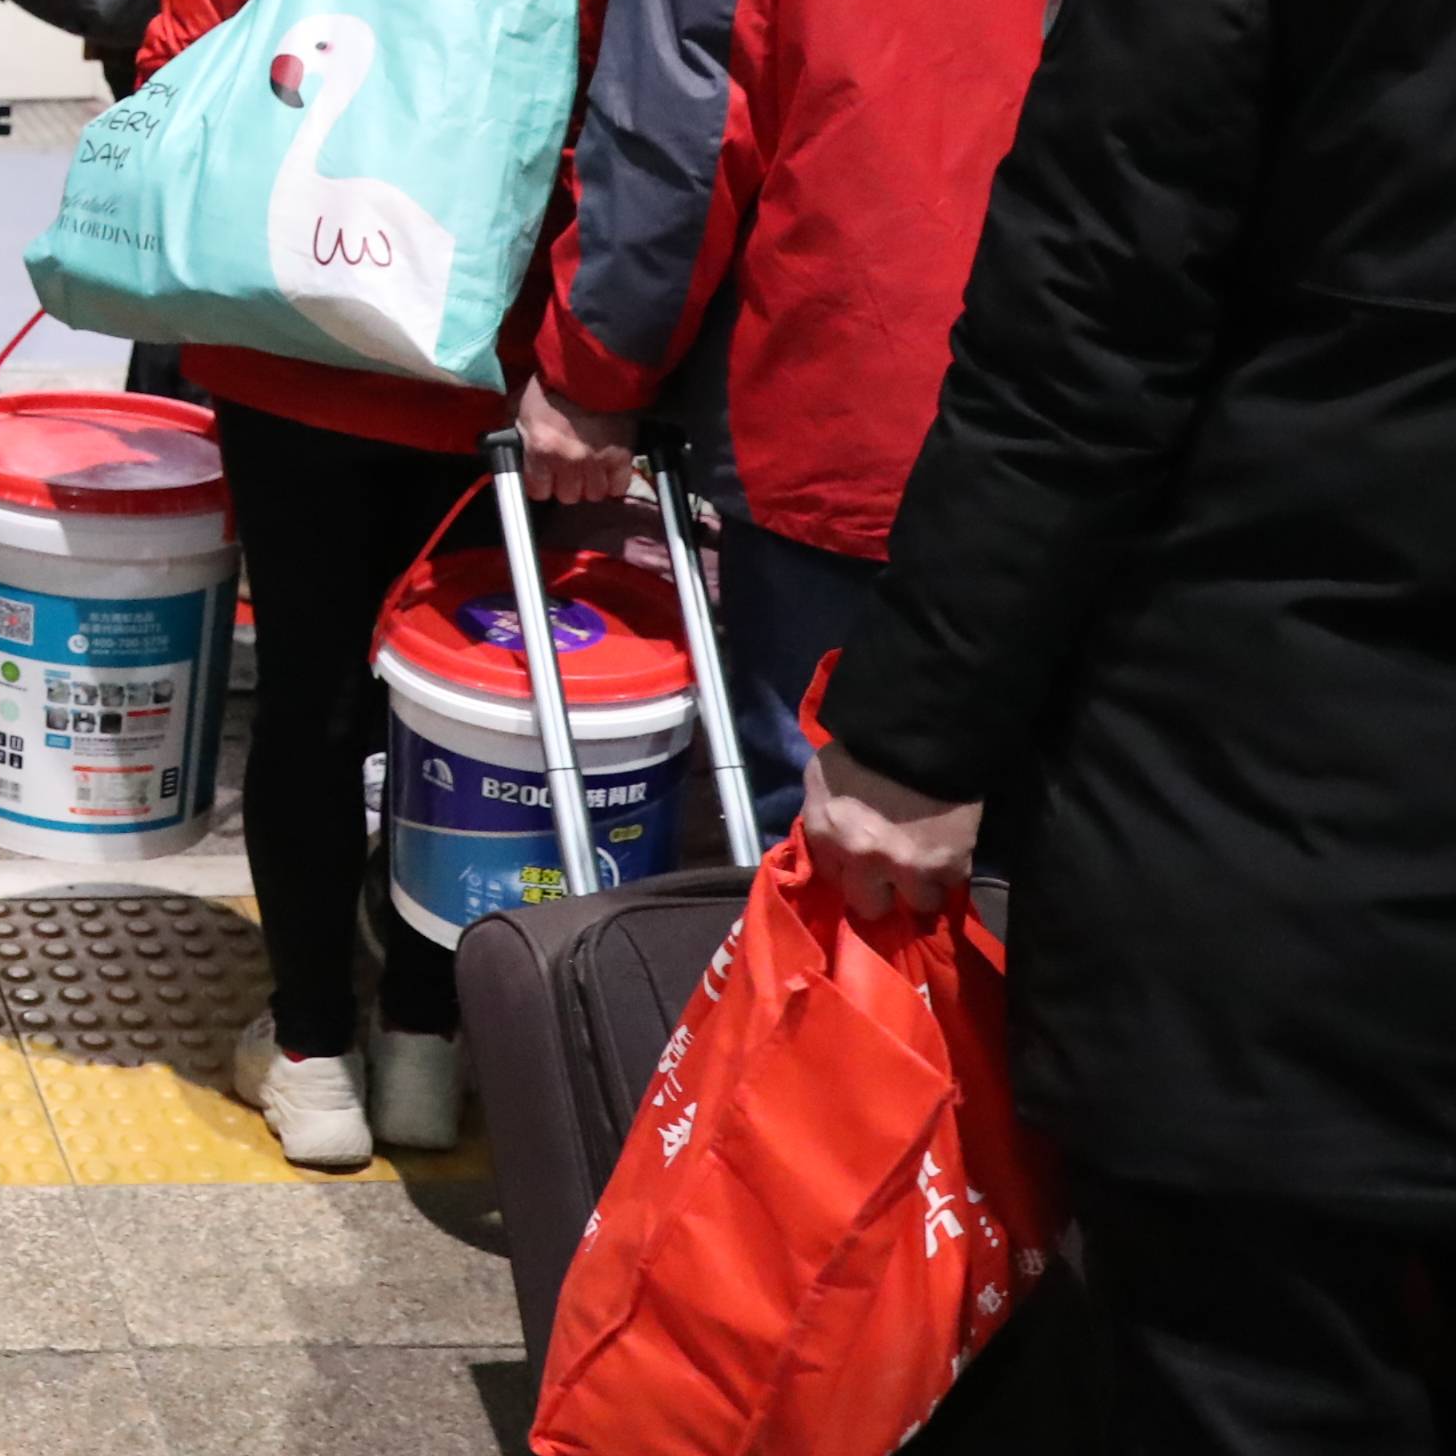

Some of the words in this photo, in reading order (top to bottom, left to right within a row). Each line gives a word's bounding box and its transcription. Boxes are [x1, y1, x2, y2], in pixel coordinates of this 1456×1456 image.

[79, 139, 132, 170] DAY!
[586, 782, 648, 808] 砖背胶
